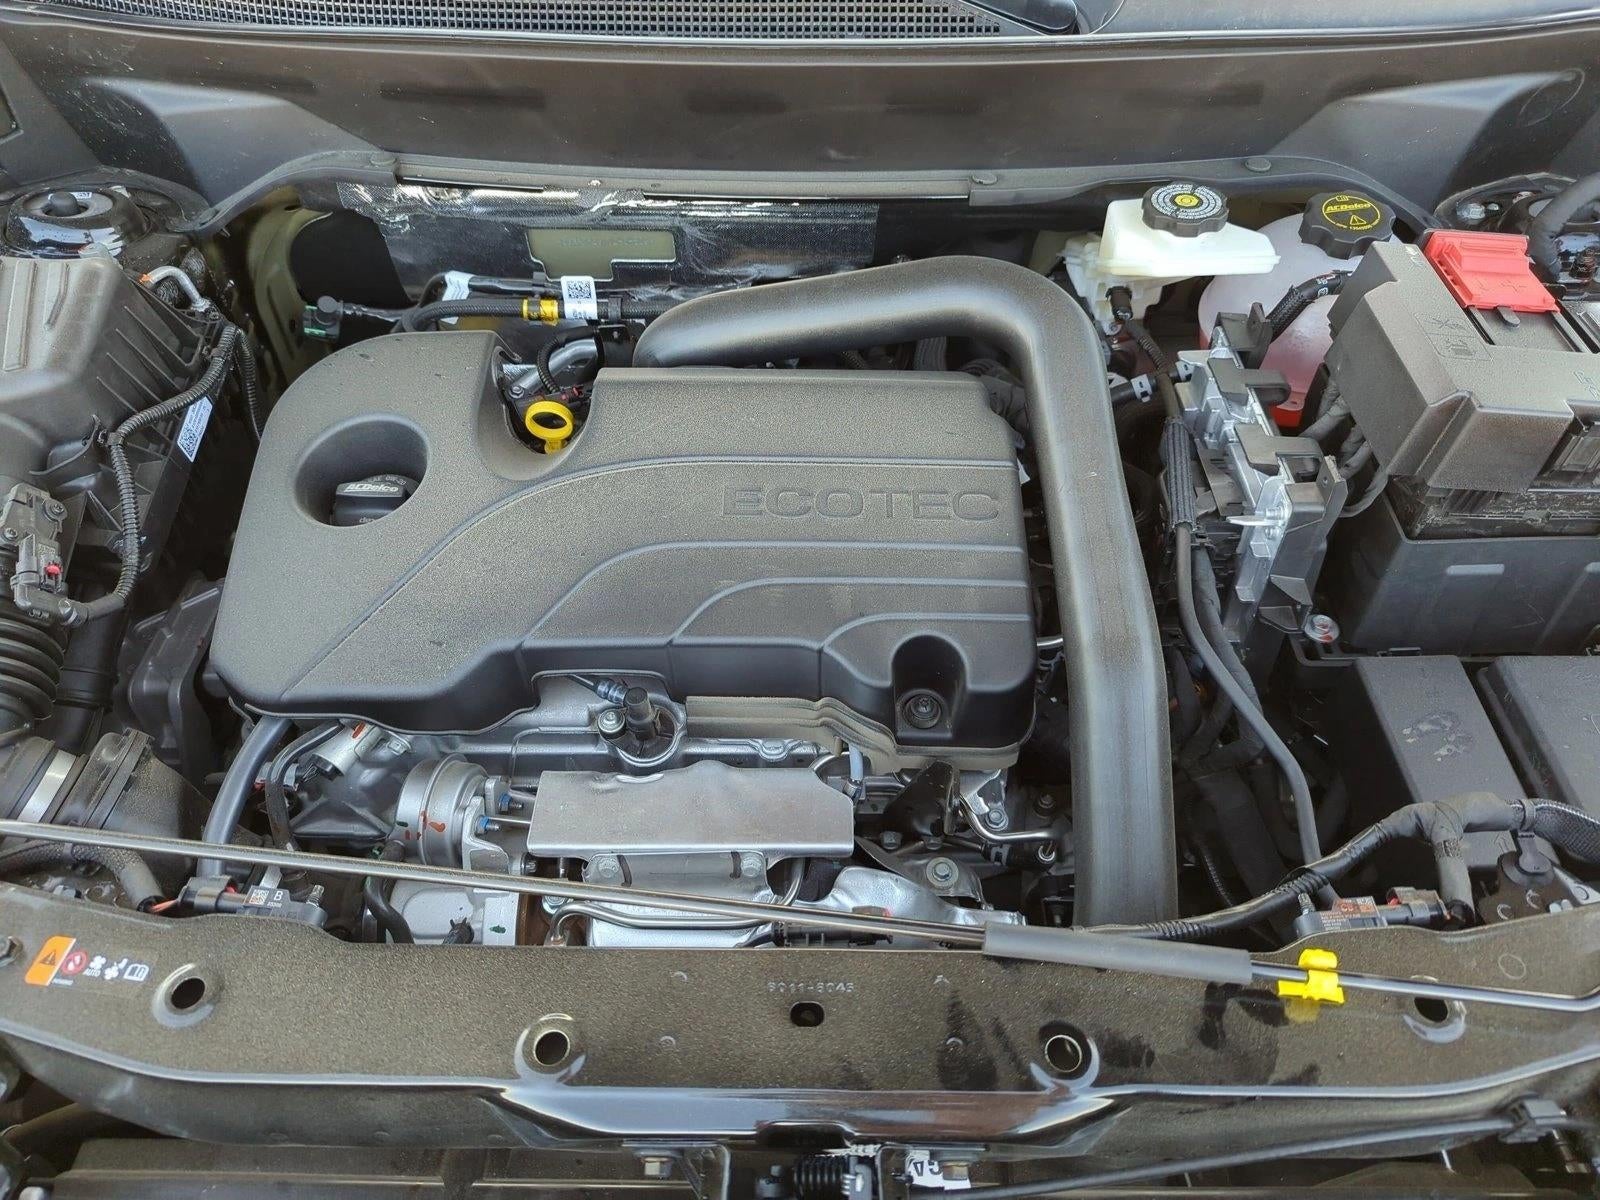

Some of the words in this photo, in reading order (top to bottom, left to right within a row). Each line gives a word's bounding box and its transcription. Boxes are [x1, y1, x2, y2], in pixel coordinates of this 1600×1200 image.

[1326, 202, 1371, 213] ACDelco
[343, 483, 399, 493] ACDelco
[722, 486, 1000, 521] ECOTEC
[273, 890, 284, 901] B
